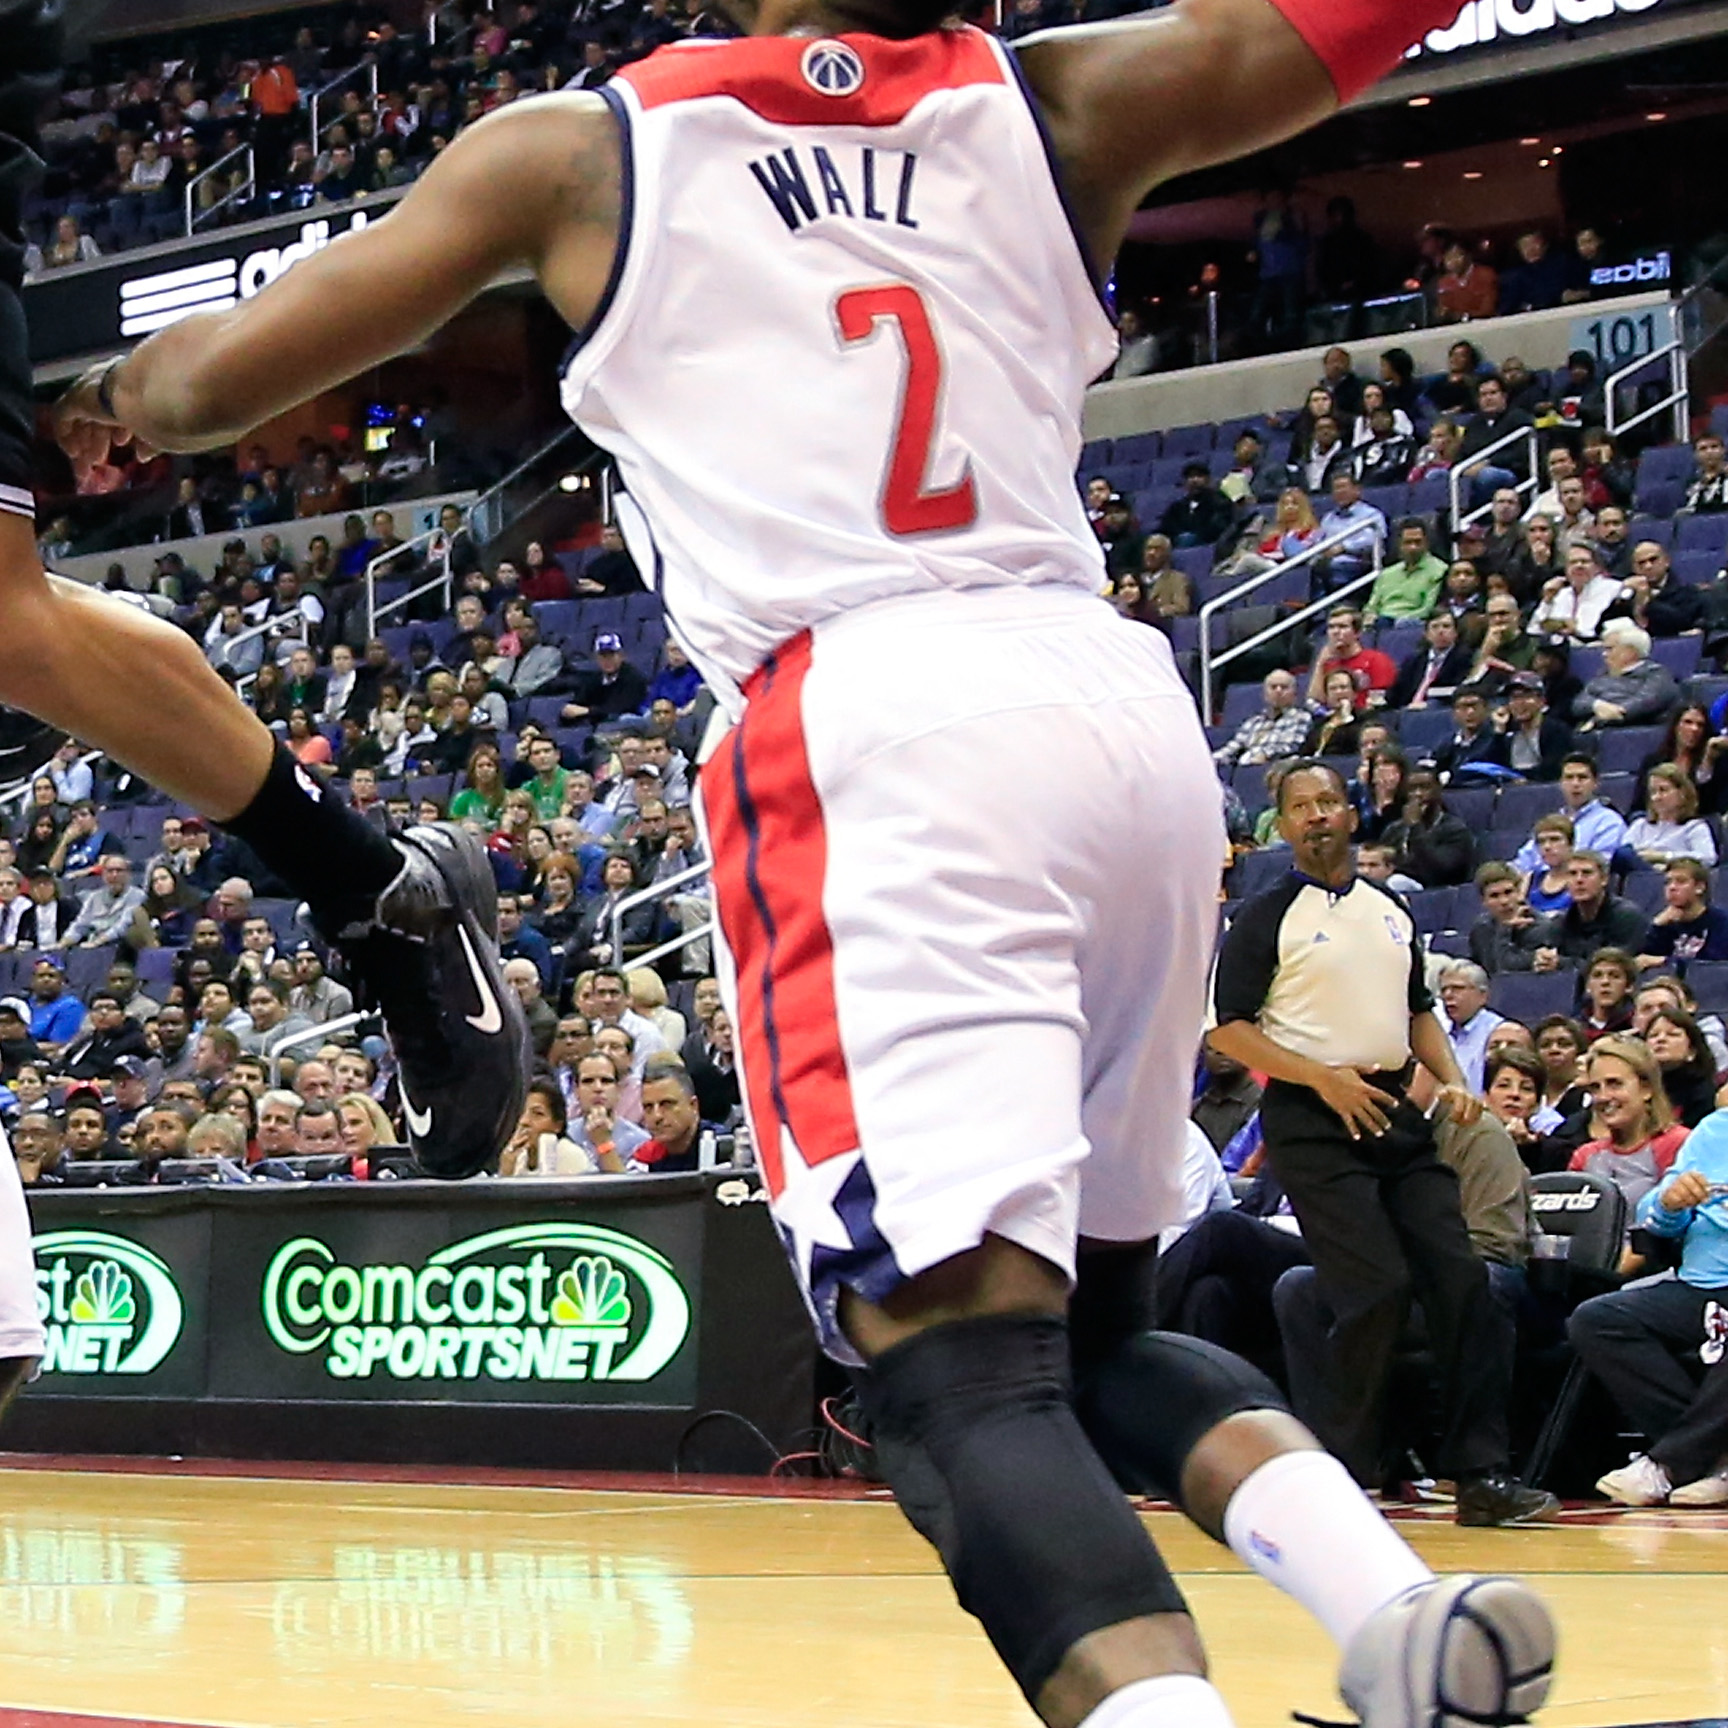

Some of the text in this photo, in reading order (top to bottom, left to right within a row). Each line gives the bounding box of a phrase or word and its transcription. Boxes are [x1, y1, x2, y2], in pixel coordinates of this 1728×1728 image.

[749, 146, 919, 233] WALL
[1588, 314, 1654, 360] 101
[834, 282, 978, 536] 2
[1531, 1184, 1601, 1211] zards
[328, 1326, 629, 1380] SPORTSNET
